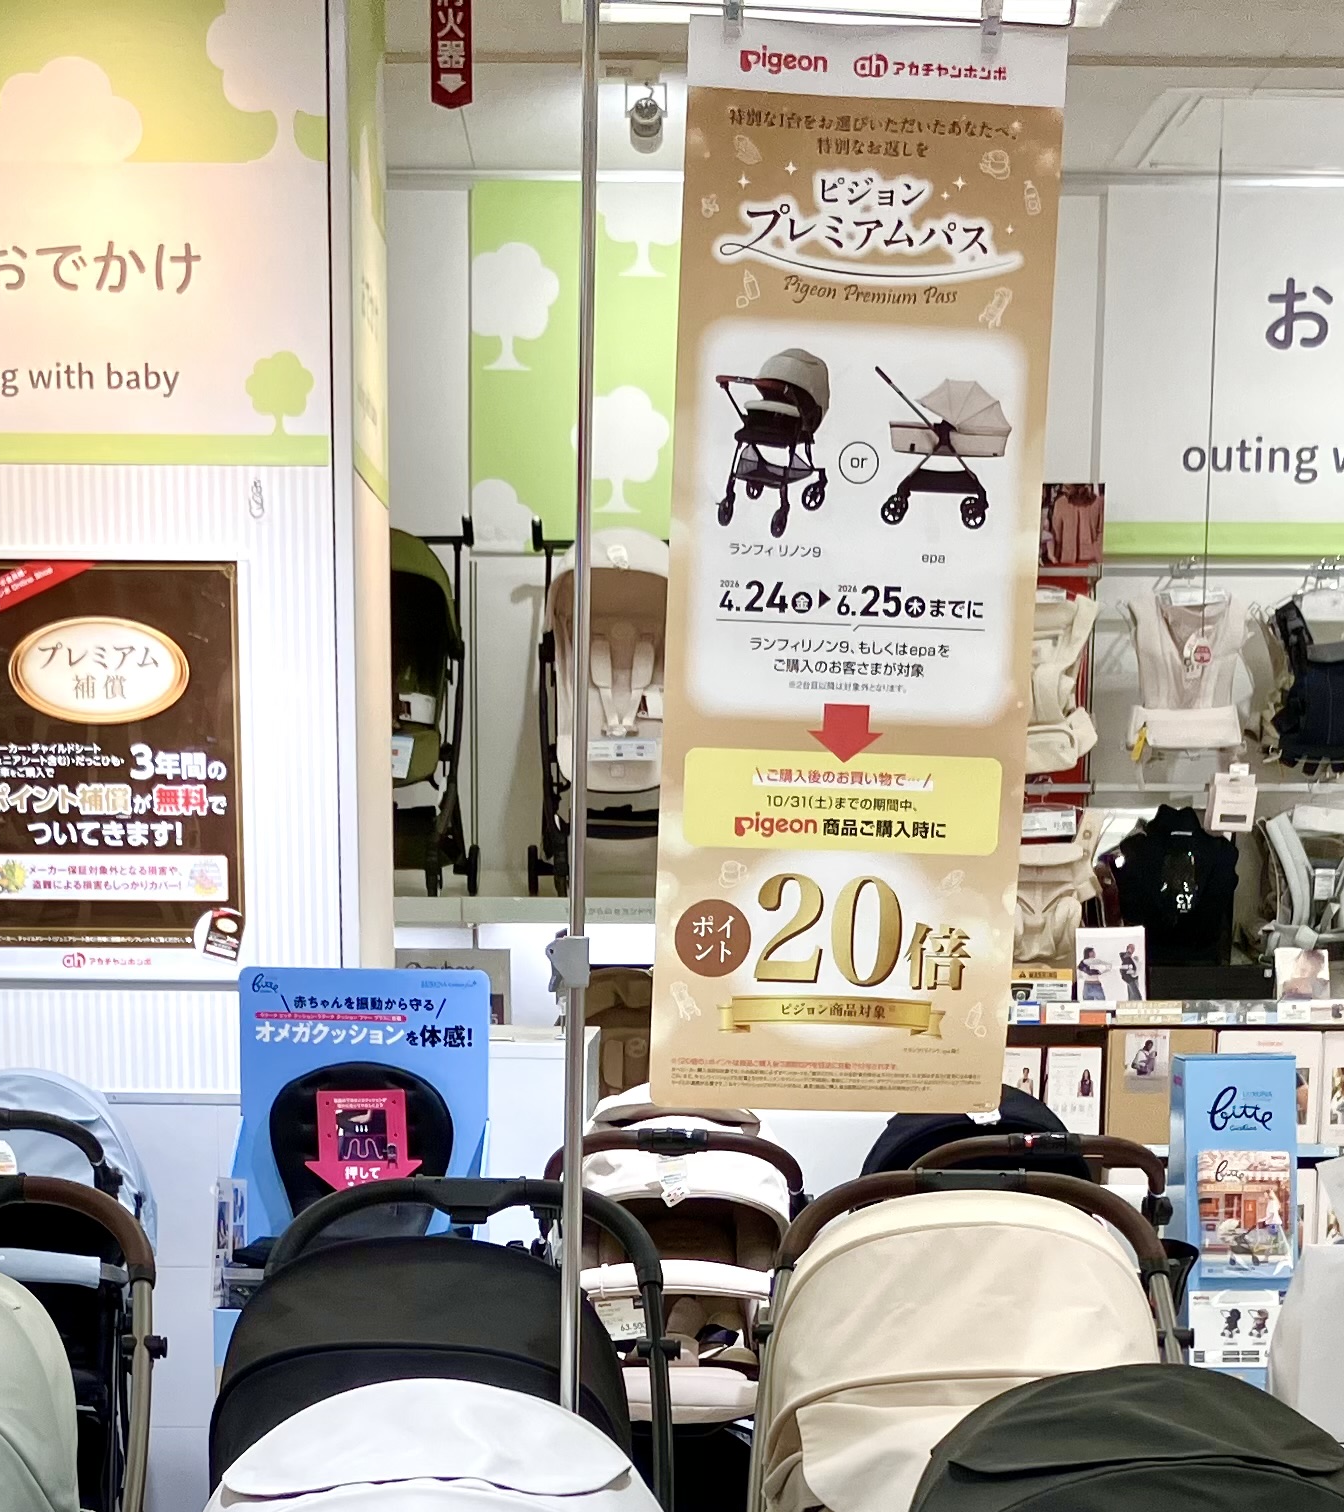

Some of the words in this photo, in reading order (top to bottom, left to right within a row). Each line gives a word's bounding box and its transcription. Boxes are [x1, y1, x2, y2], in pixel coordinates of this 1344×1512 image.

[436, 0, 465, 69] 火器
[739, 45, 828, 75] pigeon
[892, 61, 1008, 81] アカチャンホンポ
[816, 138, 930, 158] 特別なお返しを
[819, 176, 926, 208] ピジョン
[745, 203, 989, 255] プレミアムパス
[784, 274, 837, 304] Pigeon
[843, 283, 917, 305] Premium
[923, 287, 958, 305] Pass
[29, 362, 95, 390] with
[106, 362, 180, 398] baby
[850, 455, 868, 470] or
[1181, 436, 1319, 484] outing
[728, 542, 823, 559] ランフィリノン9
[921, 553, 946, 565] epa
[719, 579, 740, 589] 2026
[837, 584, 858, 594] 2026
[37, 643, 160, 670] プレミアム
[749, 636, 950, 658] ランフィリノン9、もしくはepaを
[773, 658, 925, 678] ご購入のお客さまが対象
[72, 674, 127, 700] 補償
[129, 743, 227, 781] 3年間の
[27, 821, 184, 847] ついてきます!
[734, 811, 817, 838] pigeon
[822, 818, 946, 840] 商品ご購入時に
[754, 872, 972, 992] 20倍
[293, 995, 435, 1012] 赤ちゃんを振動から守る
[255, 1021, 473, 1048] オメガクッションを体感!
[344, 1165, 381, 1180] 押して
